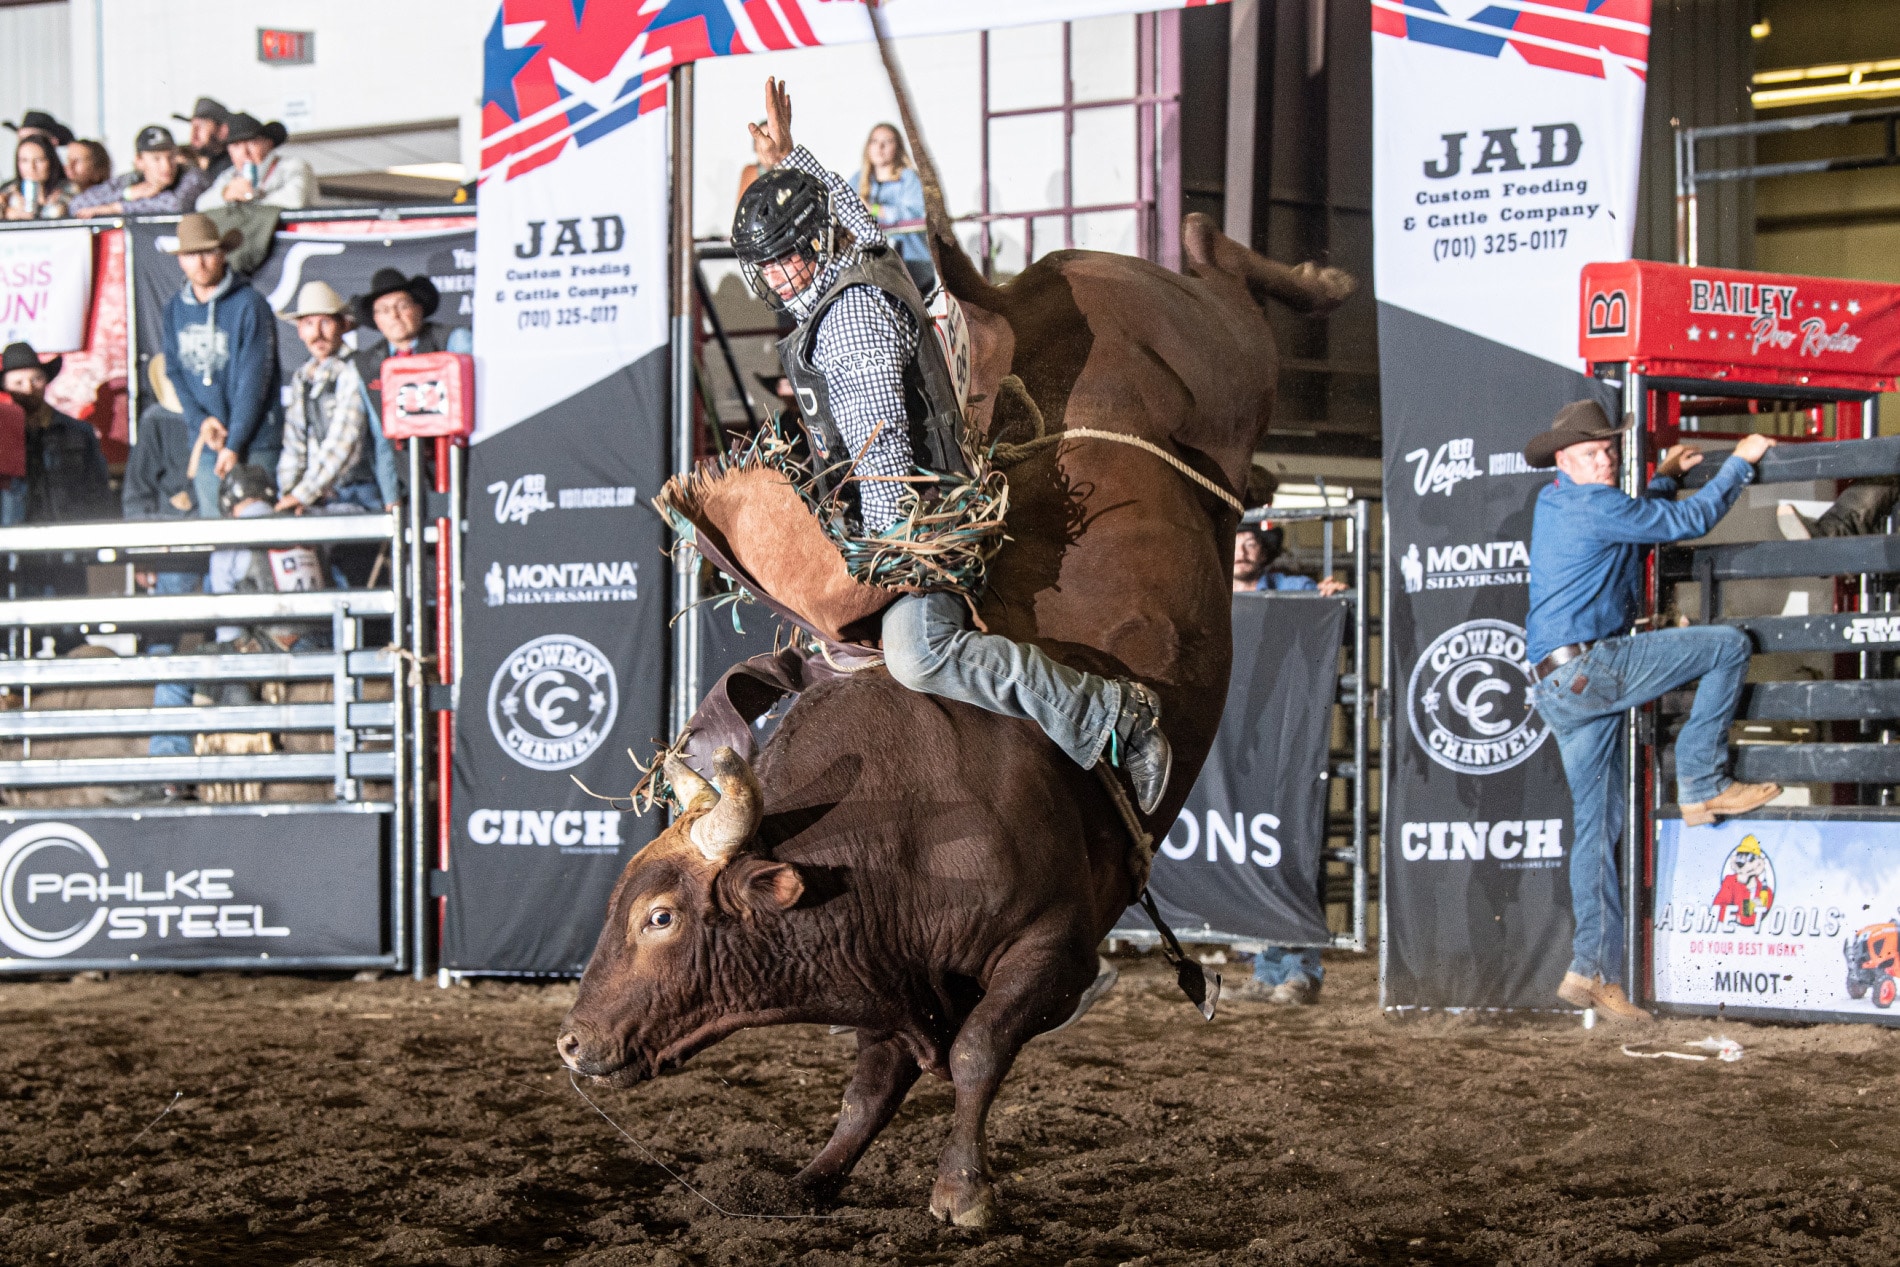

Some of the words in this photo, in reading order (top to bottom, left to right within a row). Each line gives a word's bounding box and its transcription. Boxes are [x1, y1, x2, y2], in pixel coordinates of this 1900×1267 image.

[1423, 123, 1583, 179] JAD
[1416, 188, 1490, 205] Custom
[1503, 179, 1588, 196] Feeding
[1403, 217, 1417, 231] &
[1428, 211, 1488, 229] Cattle
[1500, 203, 1600, 223] Company
[515, 215, 626, 259] JAD
[1433, 236, 1476, 261] (701)
[1484, 228, 1568, 254] 325-0117
[506, 269, 562, 281] Custom
[571, 264, 631, 277] Feeding
[515, 288, 560, 301] Cattle
[568, 284, 639, 299] Company
[1690, 279, 1797, 318] BAILEY
[1750, 315, 1797, 356] Pro
[1800, 317, 1862, 358] Rodeo
[830, 348, 885, 371] ARENA
[842, 358, 887, 373] WEAR
[1405, 443, 1483, 497] Vegas
[1427, 541, 1531, 573] MONTA
[507, 561, 637, 589] MONTANA
[510, 644, 607, 684] COWBOY
[506, 727, 599, 762] CHANNEL
[1428, 724, 1538, 765] CHANNEL
[468, 809, 622, 847] CINCH
[1401, 819, 1563, 861] CINCH
[27, 868, 235, 904] PAHLKE
[107, 905, 291, 940] STEEL
[1656, 903, 1739, 934] ACME
[1752, 906, 1842, 937] TOOLS
[1690, 941, 1704, 954] DO
[1708, 941, 1734, 954] YOUR
[1737, 942, 1763, 955] BEST
[1714, 971, 1781, 994] MINOT
